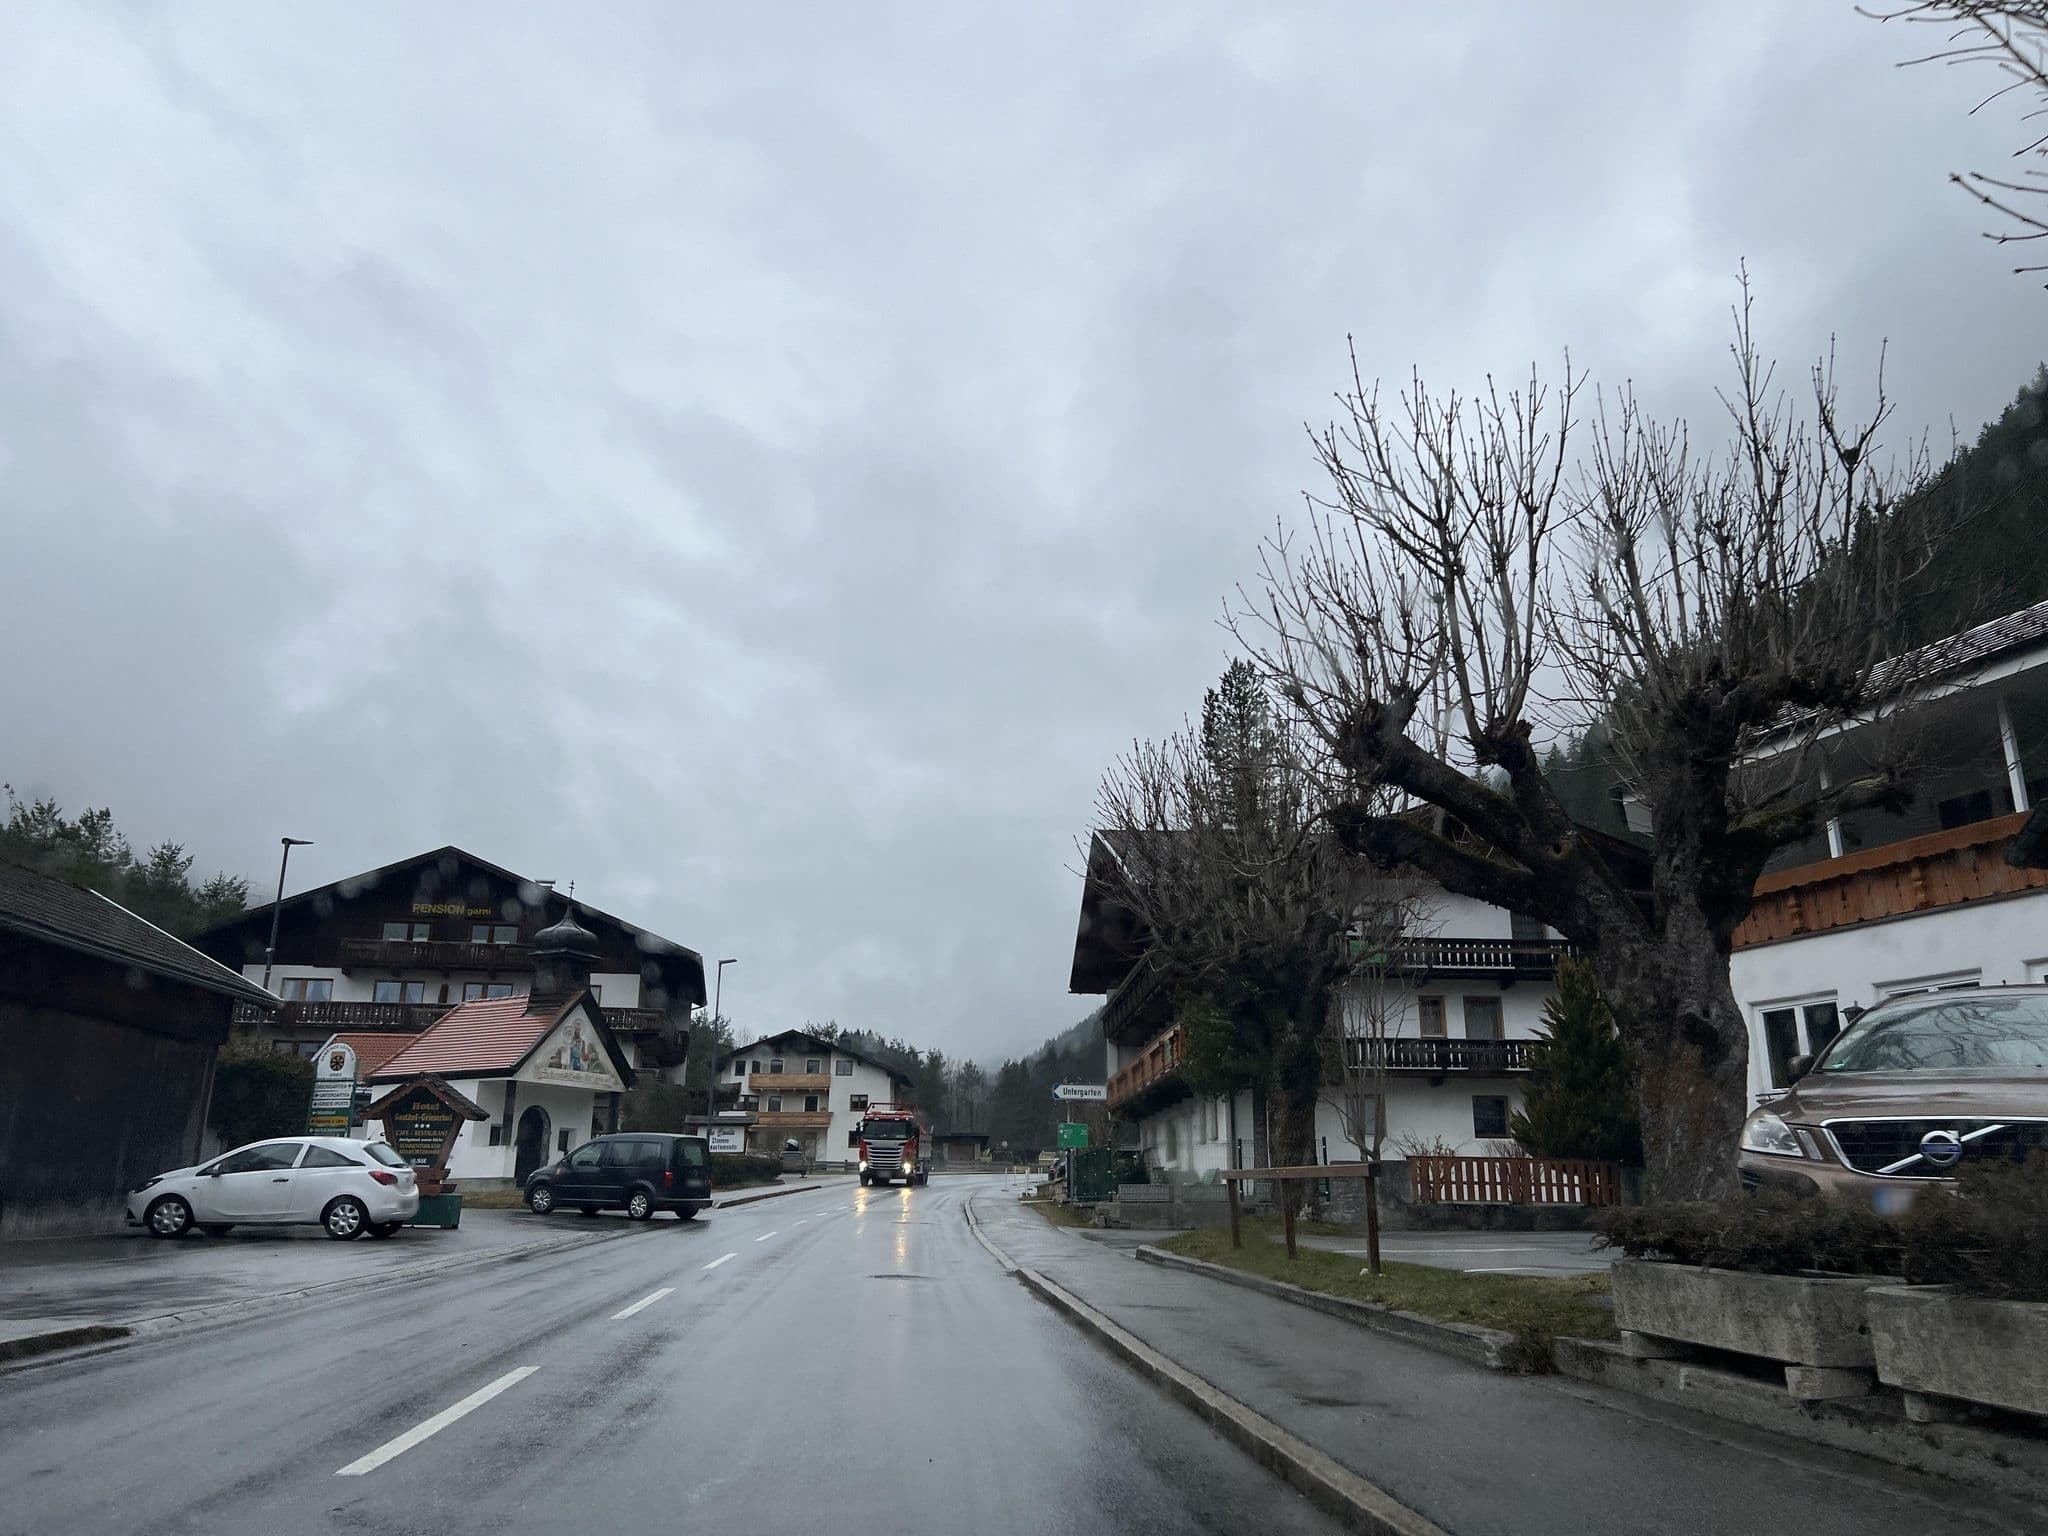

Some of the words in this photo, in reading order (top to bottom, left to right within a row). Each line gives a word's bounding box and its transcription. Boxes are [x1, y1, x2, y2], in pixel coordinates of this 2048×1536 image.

[412, 903, 465, 914] PENSION
[1063, 1088, 1102, 1097] Untergarten
[413, 1102, 439, 1110] Hotel
